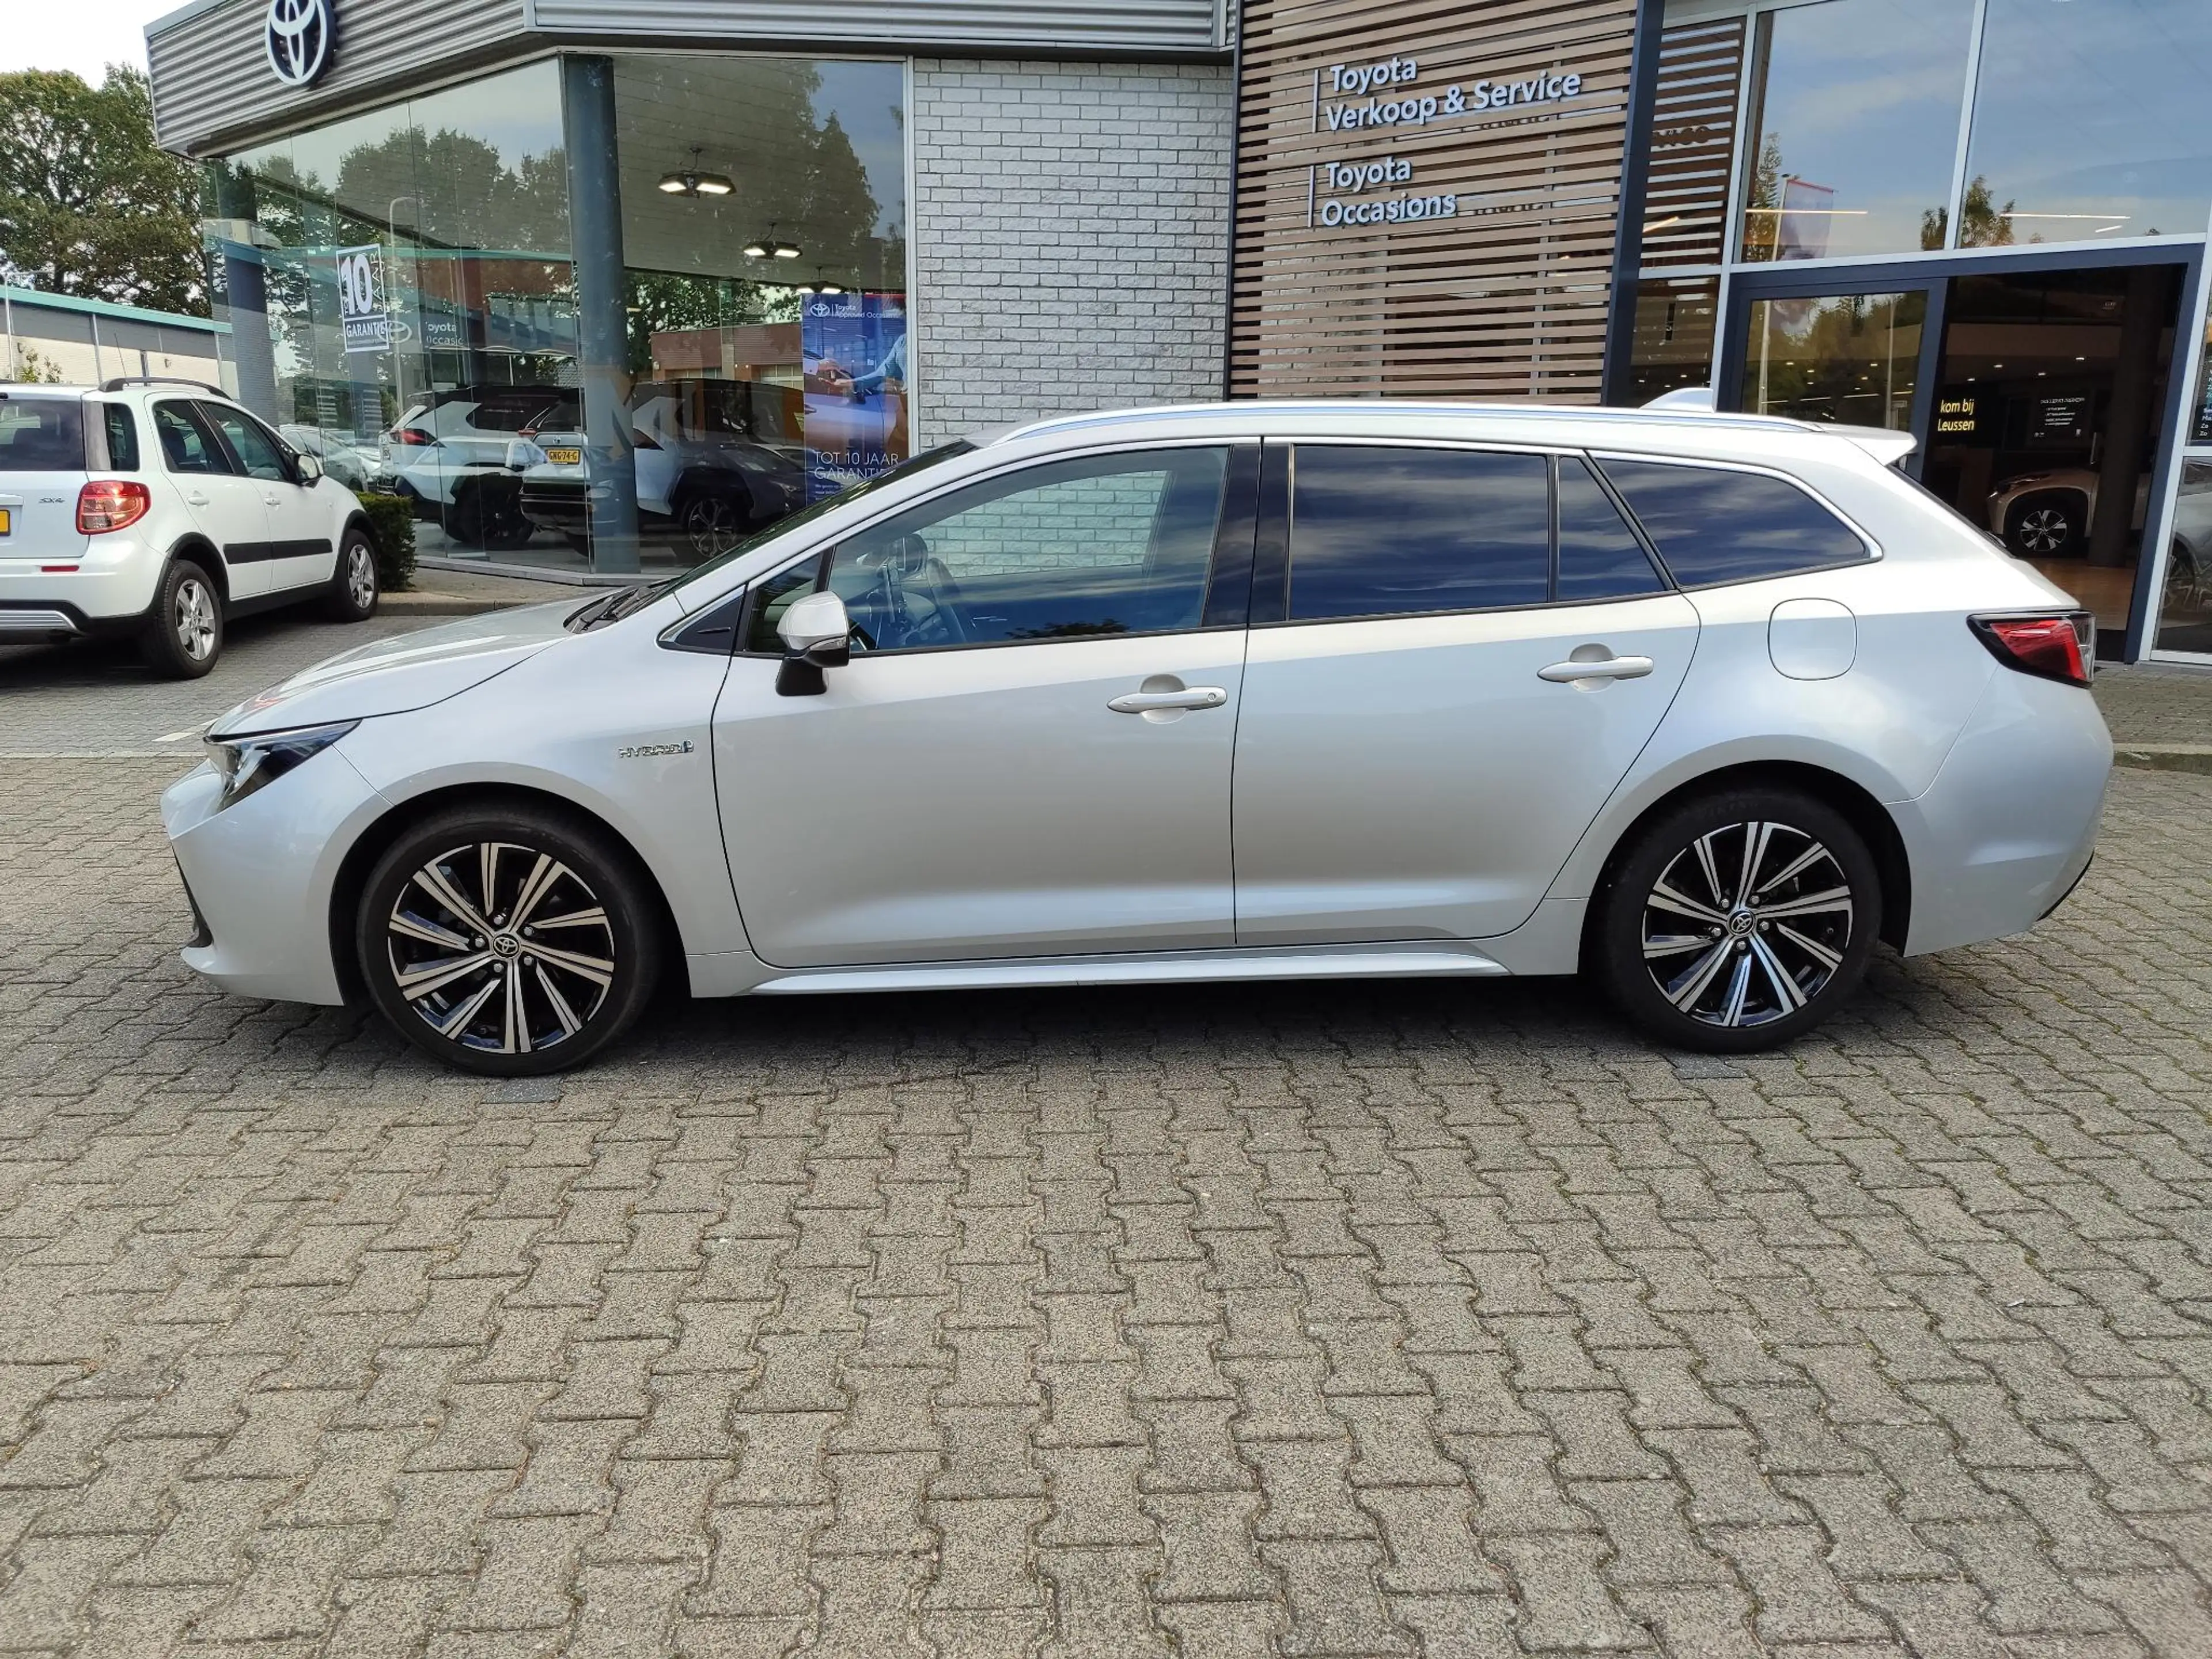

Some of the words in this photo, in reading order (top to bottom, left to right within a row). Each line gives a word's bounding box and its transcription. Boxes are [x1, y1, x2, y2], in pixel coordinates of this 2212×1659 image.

[1330, 56, 1417, 95] Toyota
[1326, 96, 1437, 131] Verkoop
[1444, 85, 1465, 113] &
[1473, 70, 1582, 109] Service
[1325, 156, 1411, 192] Toyota
[1321, 192, 1457, 226] Occasions
[340, 254, 372, 314] 10
[835, 303, 856, 312] Toyota
[425, 321, 457, 334] oyota
[1940, 399, 1960, 413] kom
[1962, 398, 1974, 415] bij
[1937, 418, 1975, 431] Leussen
[815, 451, 840, 464] TOT
[846, 452, 859, 465] 10
[864, 452, 899, 465] JAAR
